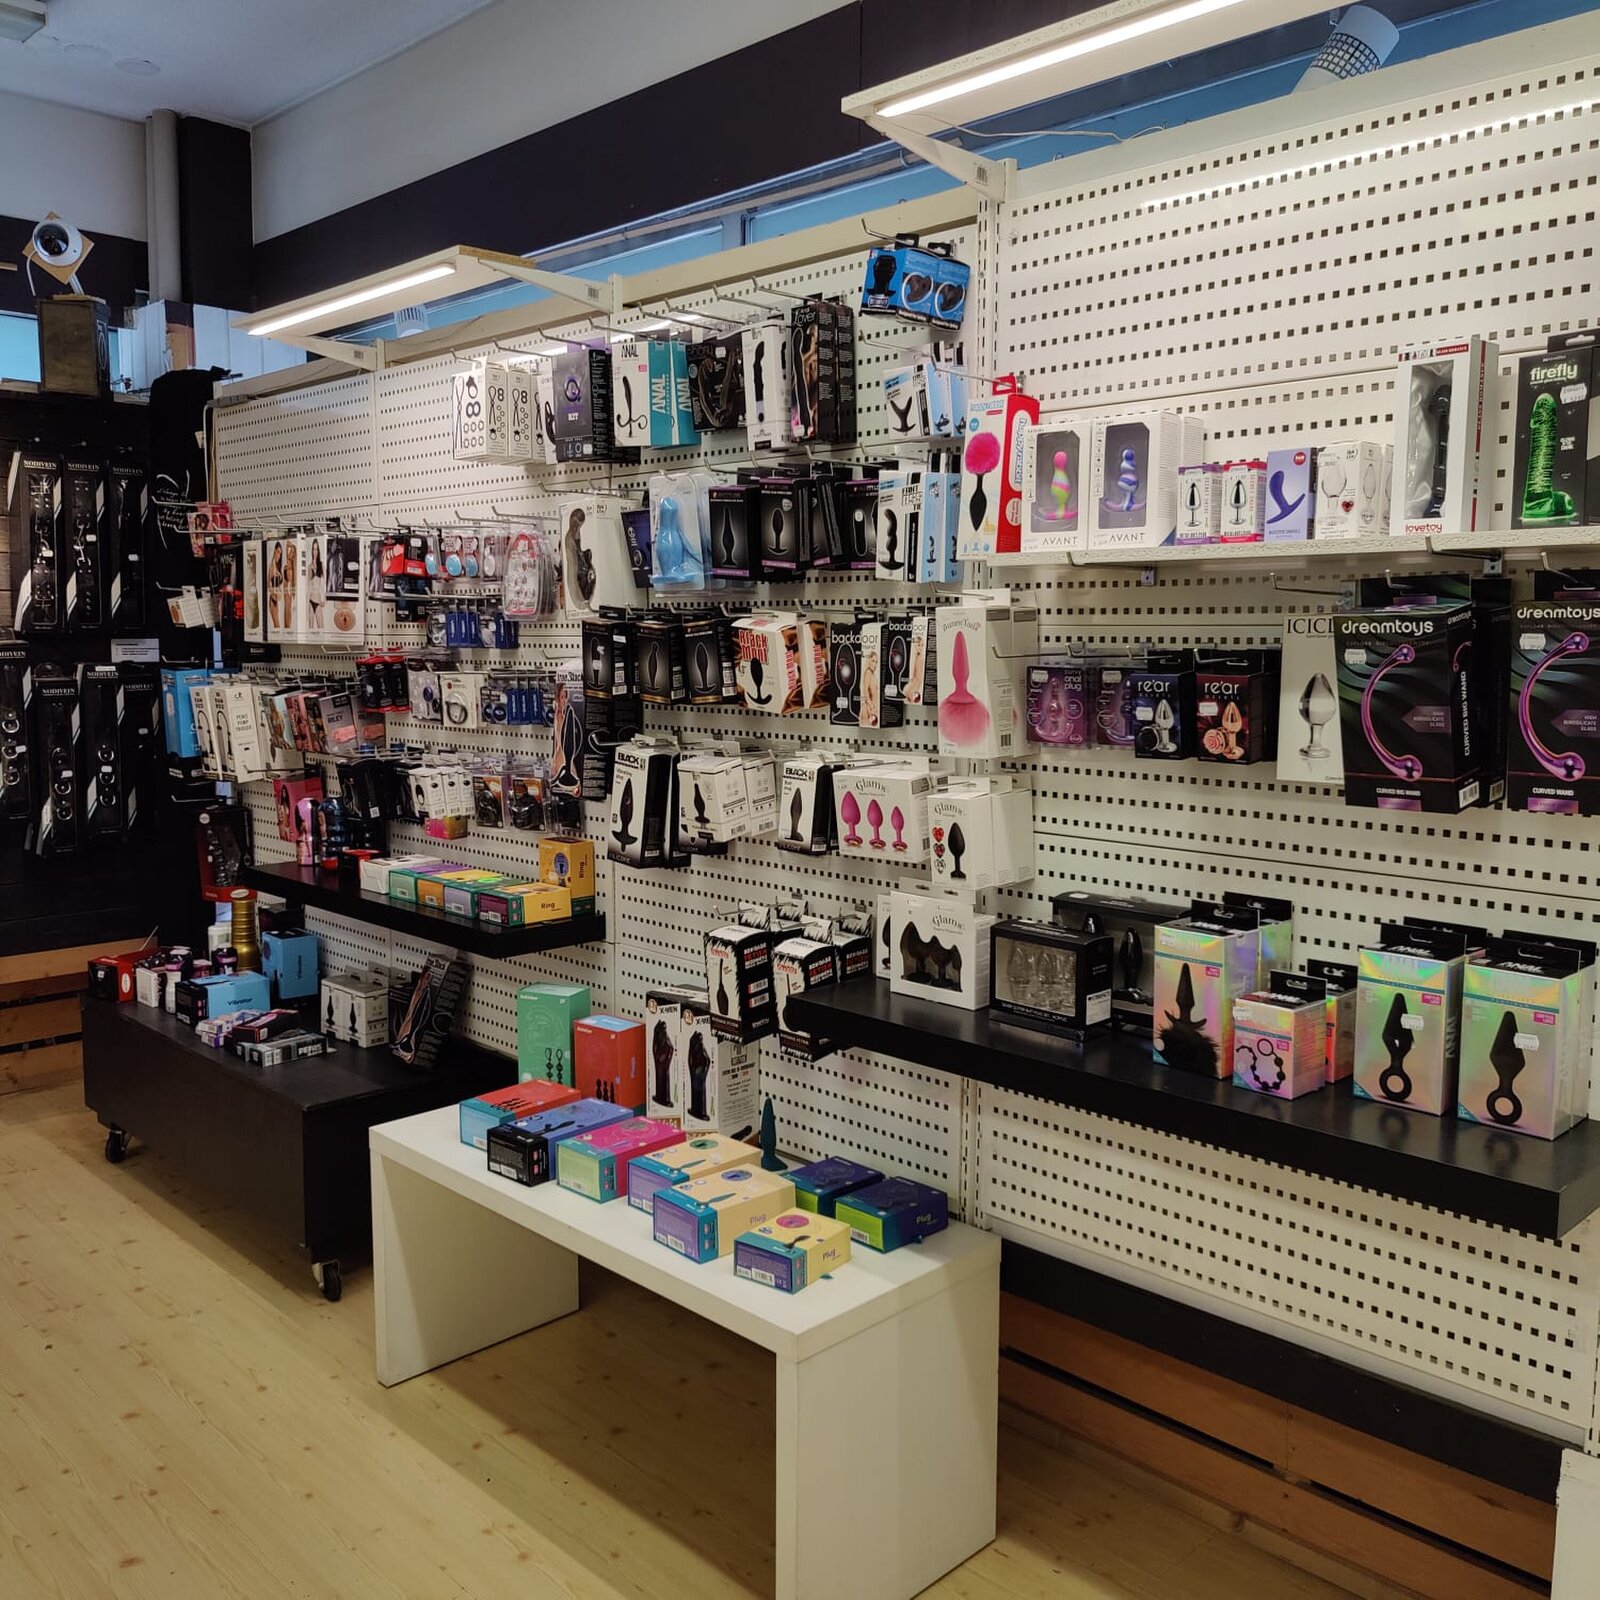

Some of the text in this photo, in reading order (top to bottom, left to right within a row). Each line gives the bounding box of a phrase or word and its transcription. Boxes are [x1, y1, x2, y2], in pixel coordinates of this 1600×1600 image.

[621, 344, 639, 358] ANAL
[1530, 363, 1578, 380] firefly
[652, 374, 666, 414] ANAL
[1405, 522, 1443, 534] lovetoy
[1042, 536, 1078, 546] AVANT
[1109, 532, 1145, 543] AVANT
[1517, 605, 1600, 621] dreamtoys
[1341, 620, 1434, 636] dreamtoys
[1137, 680, 1170, 694] rear
[1204, 680, 1239, 696] rear
[1463, 718, 1471, 757] CURVED
[617, 752, 640, 765] BLACK
[785, 767, 808, 778] BLACK
